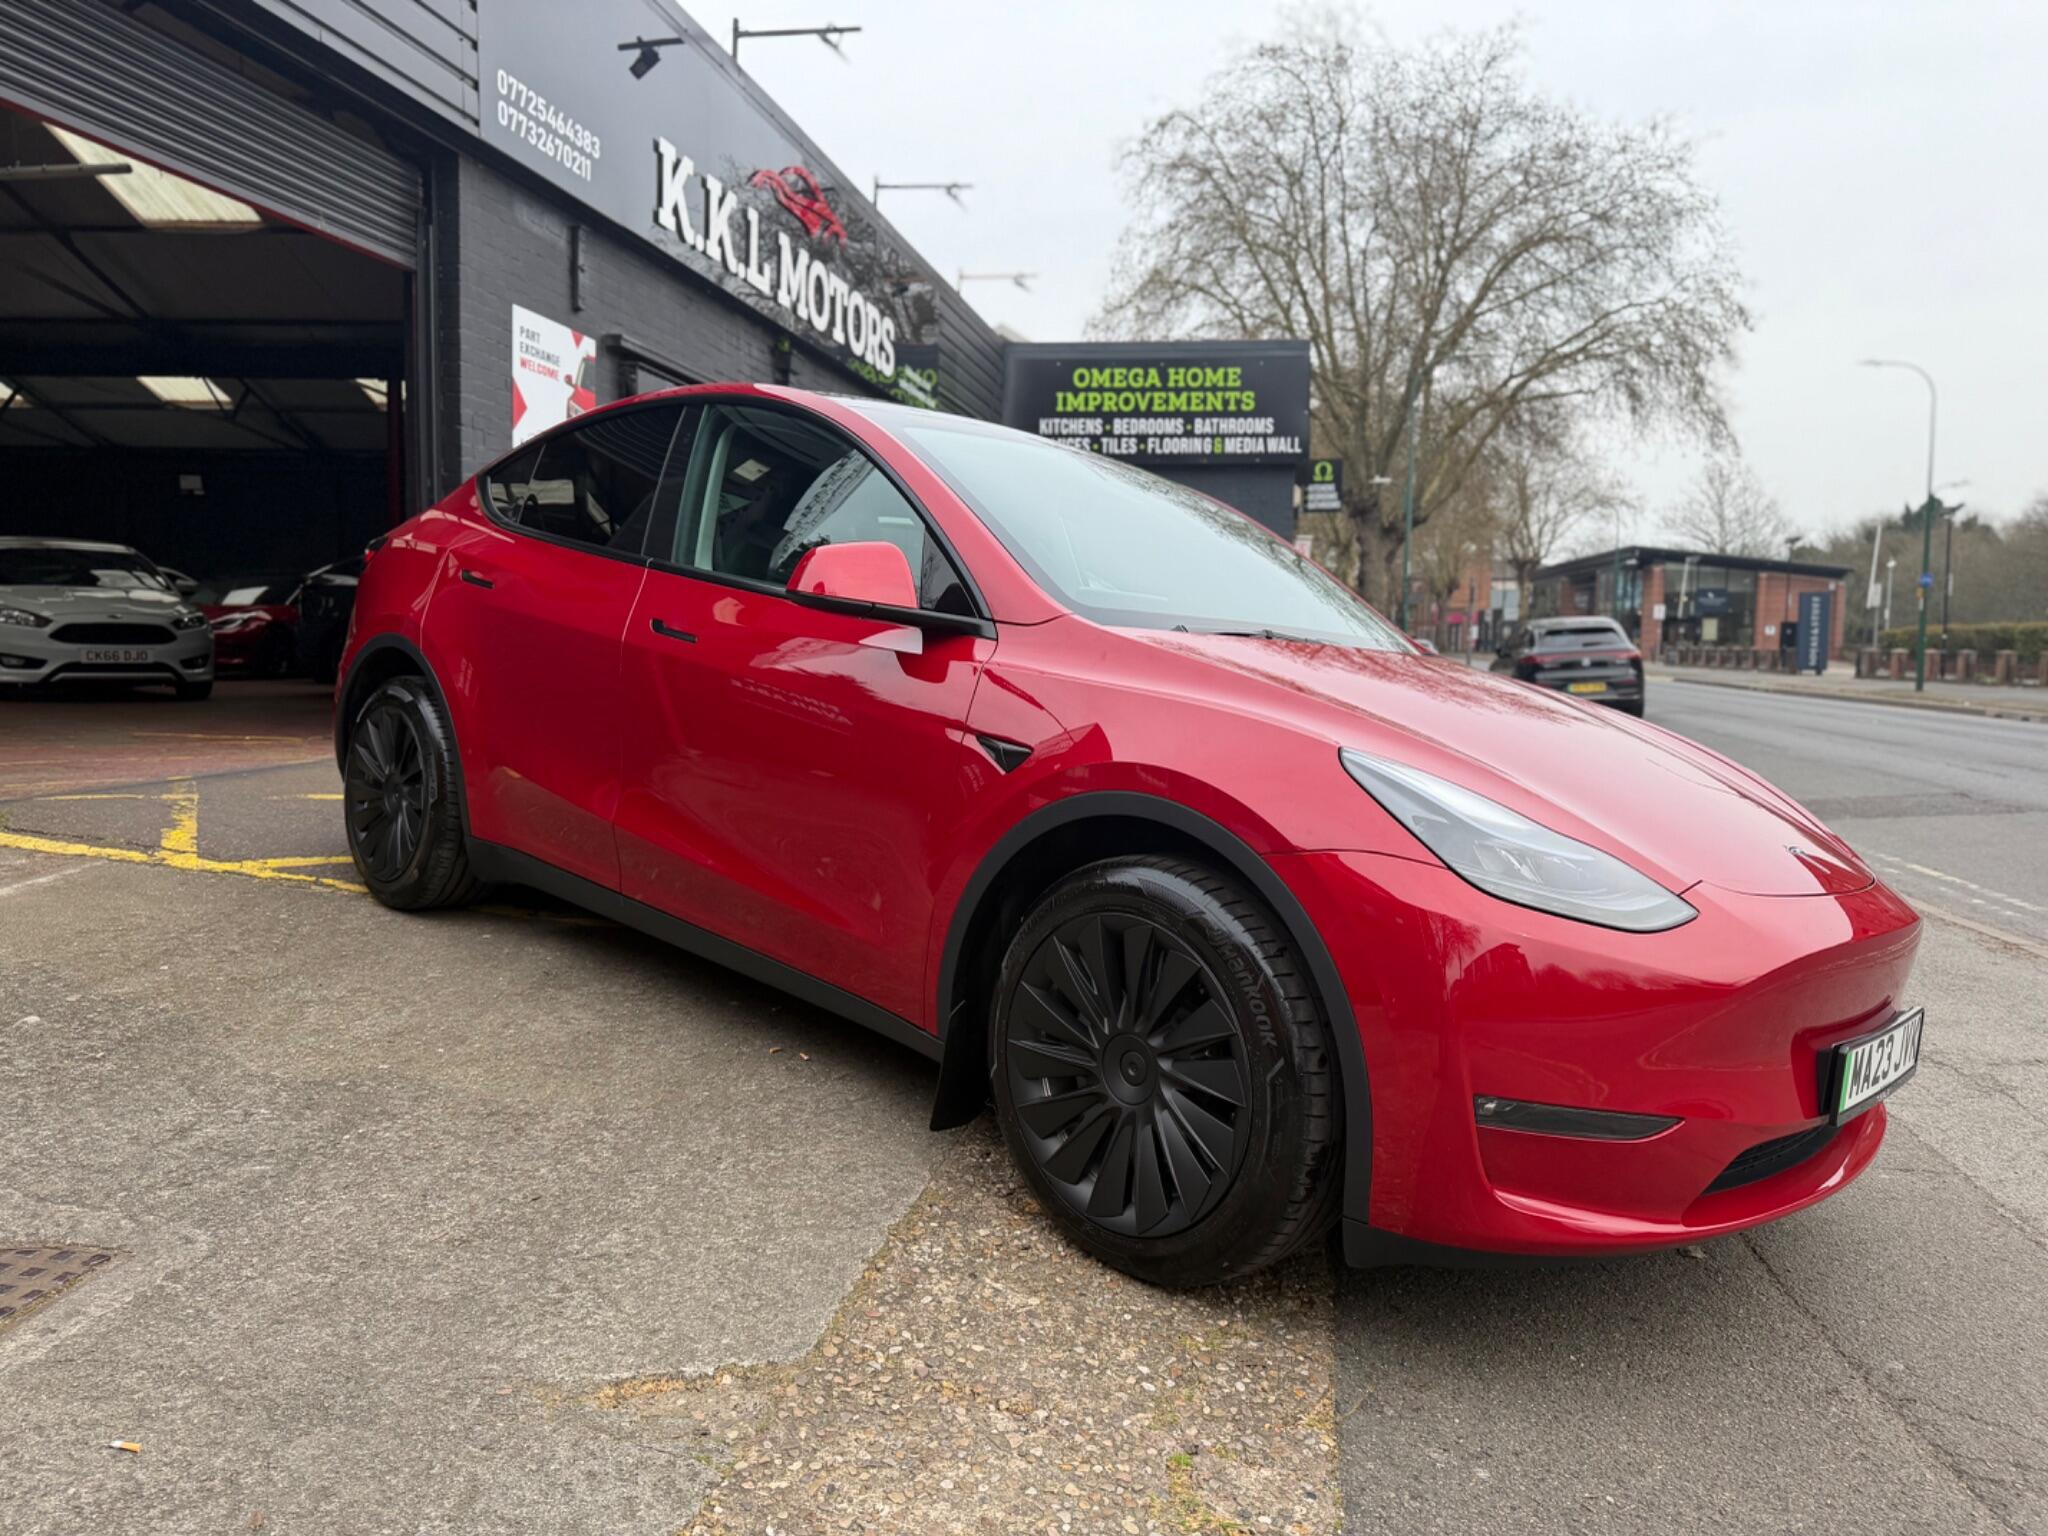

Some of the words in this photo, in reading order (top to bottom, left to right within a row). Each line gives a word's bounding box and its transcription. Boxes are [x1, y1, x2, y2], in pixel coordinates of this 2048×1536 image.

[497, 69, 600, 159] 07725464383
[498, 100, 592, 182] 07732670211
[776, 232, 896, 377] MOTORS
[519, 325, 541, 343] PART
[519, 341, 561, 367] EXCHANGE
[519, 356, 560, 382] WELCOME
[1073, 367, 1162, 388] OMEGA
[1167, 367, 1242, 388] HOME
[1055, 391, 1256, 412] IMPROVEMENTS
[1039, 418, 1103, 436] KITCHENS
[1113, 418, 1184, 435] BEDROOMS
[1194, 417, 1275, 435] BATHROOMS
[1101, 437, 1138, 454] TILES
[1147, 437, 1212, 454] FLOORING
[1224, 437, 1265, 454] MEDIA
[1266, 436, 1302, 454] WALL
[86, 650, 120, 662] CK66
[1849, 1034, 1895, 1099] MA23
